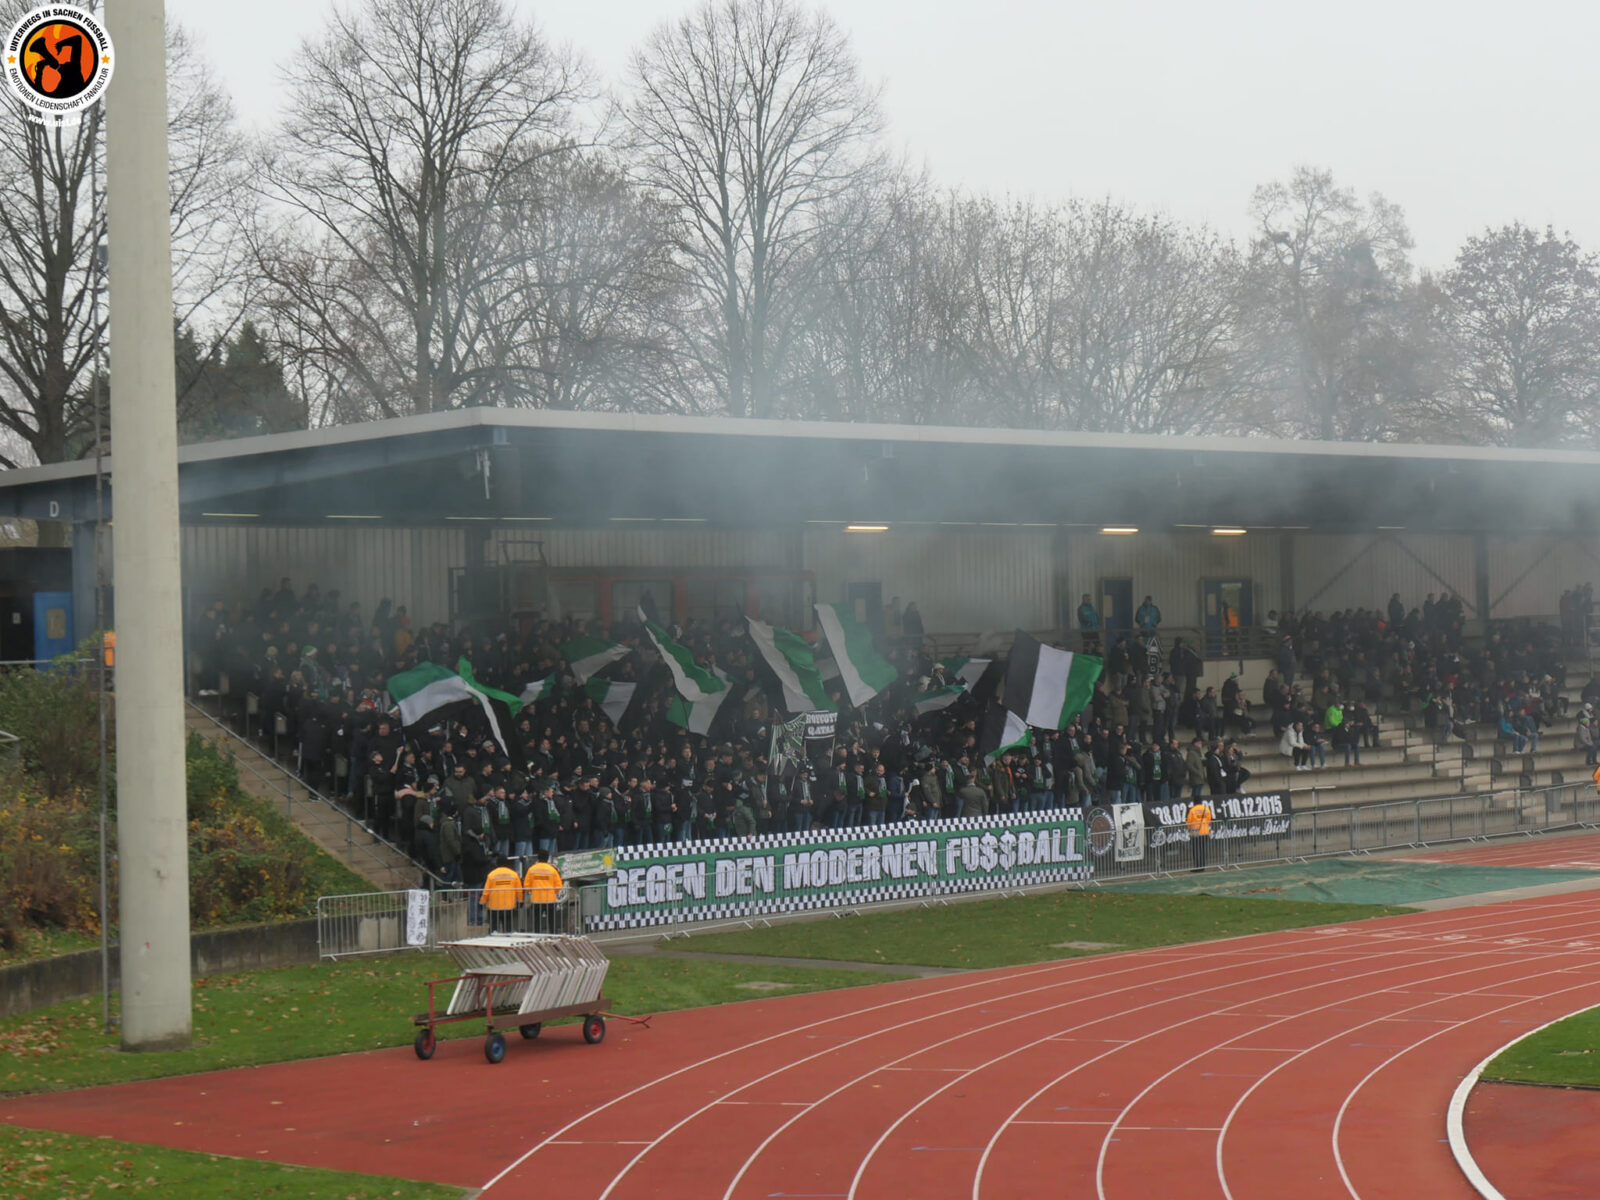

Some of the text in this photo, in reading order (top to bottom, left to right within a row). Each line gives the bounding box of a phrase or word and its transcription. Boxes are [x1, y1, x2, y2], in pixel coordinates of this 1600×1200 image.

[49, 500, 60, 518] D
[606, 860, 707, 909] GEGEN
[714, 854, 776, 898] DEN
[782, 838, 939, 892] MODERNEN
[945, 825, 1084, 876] FU$$BALL
